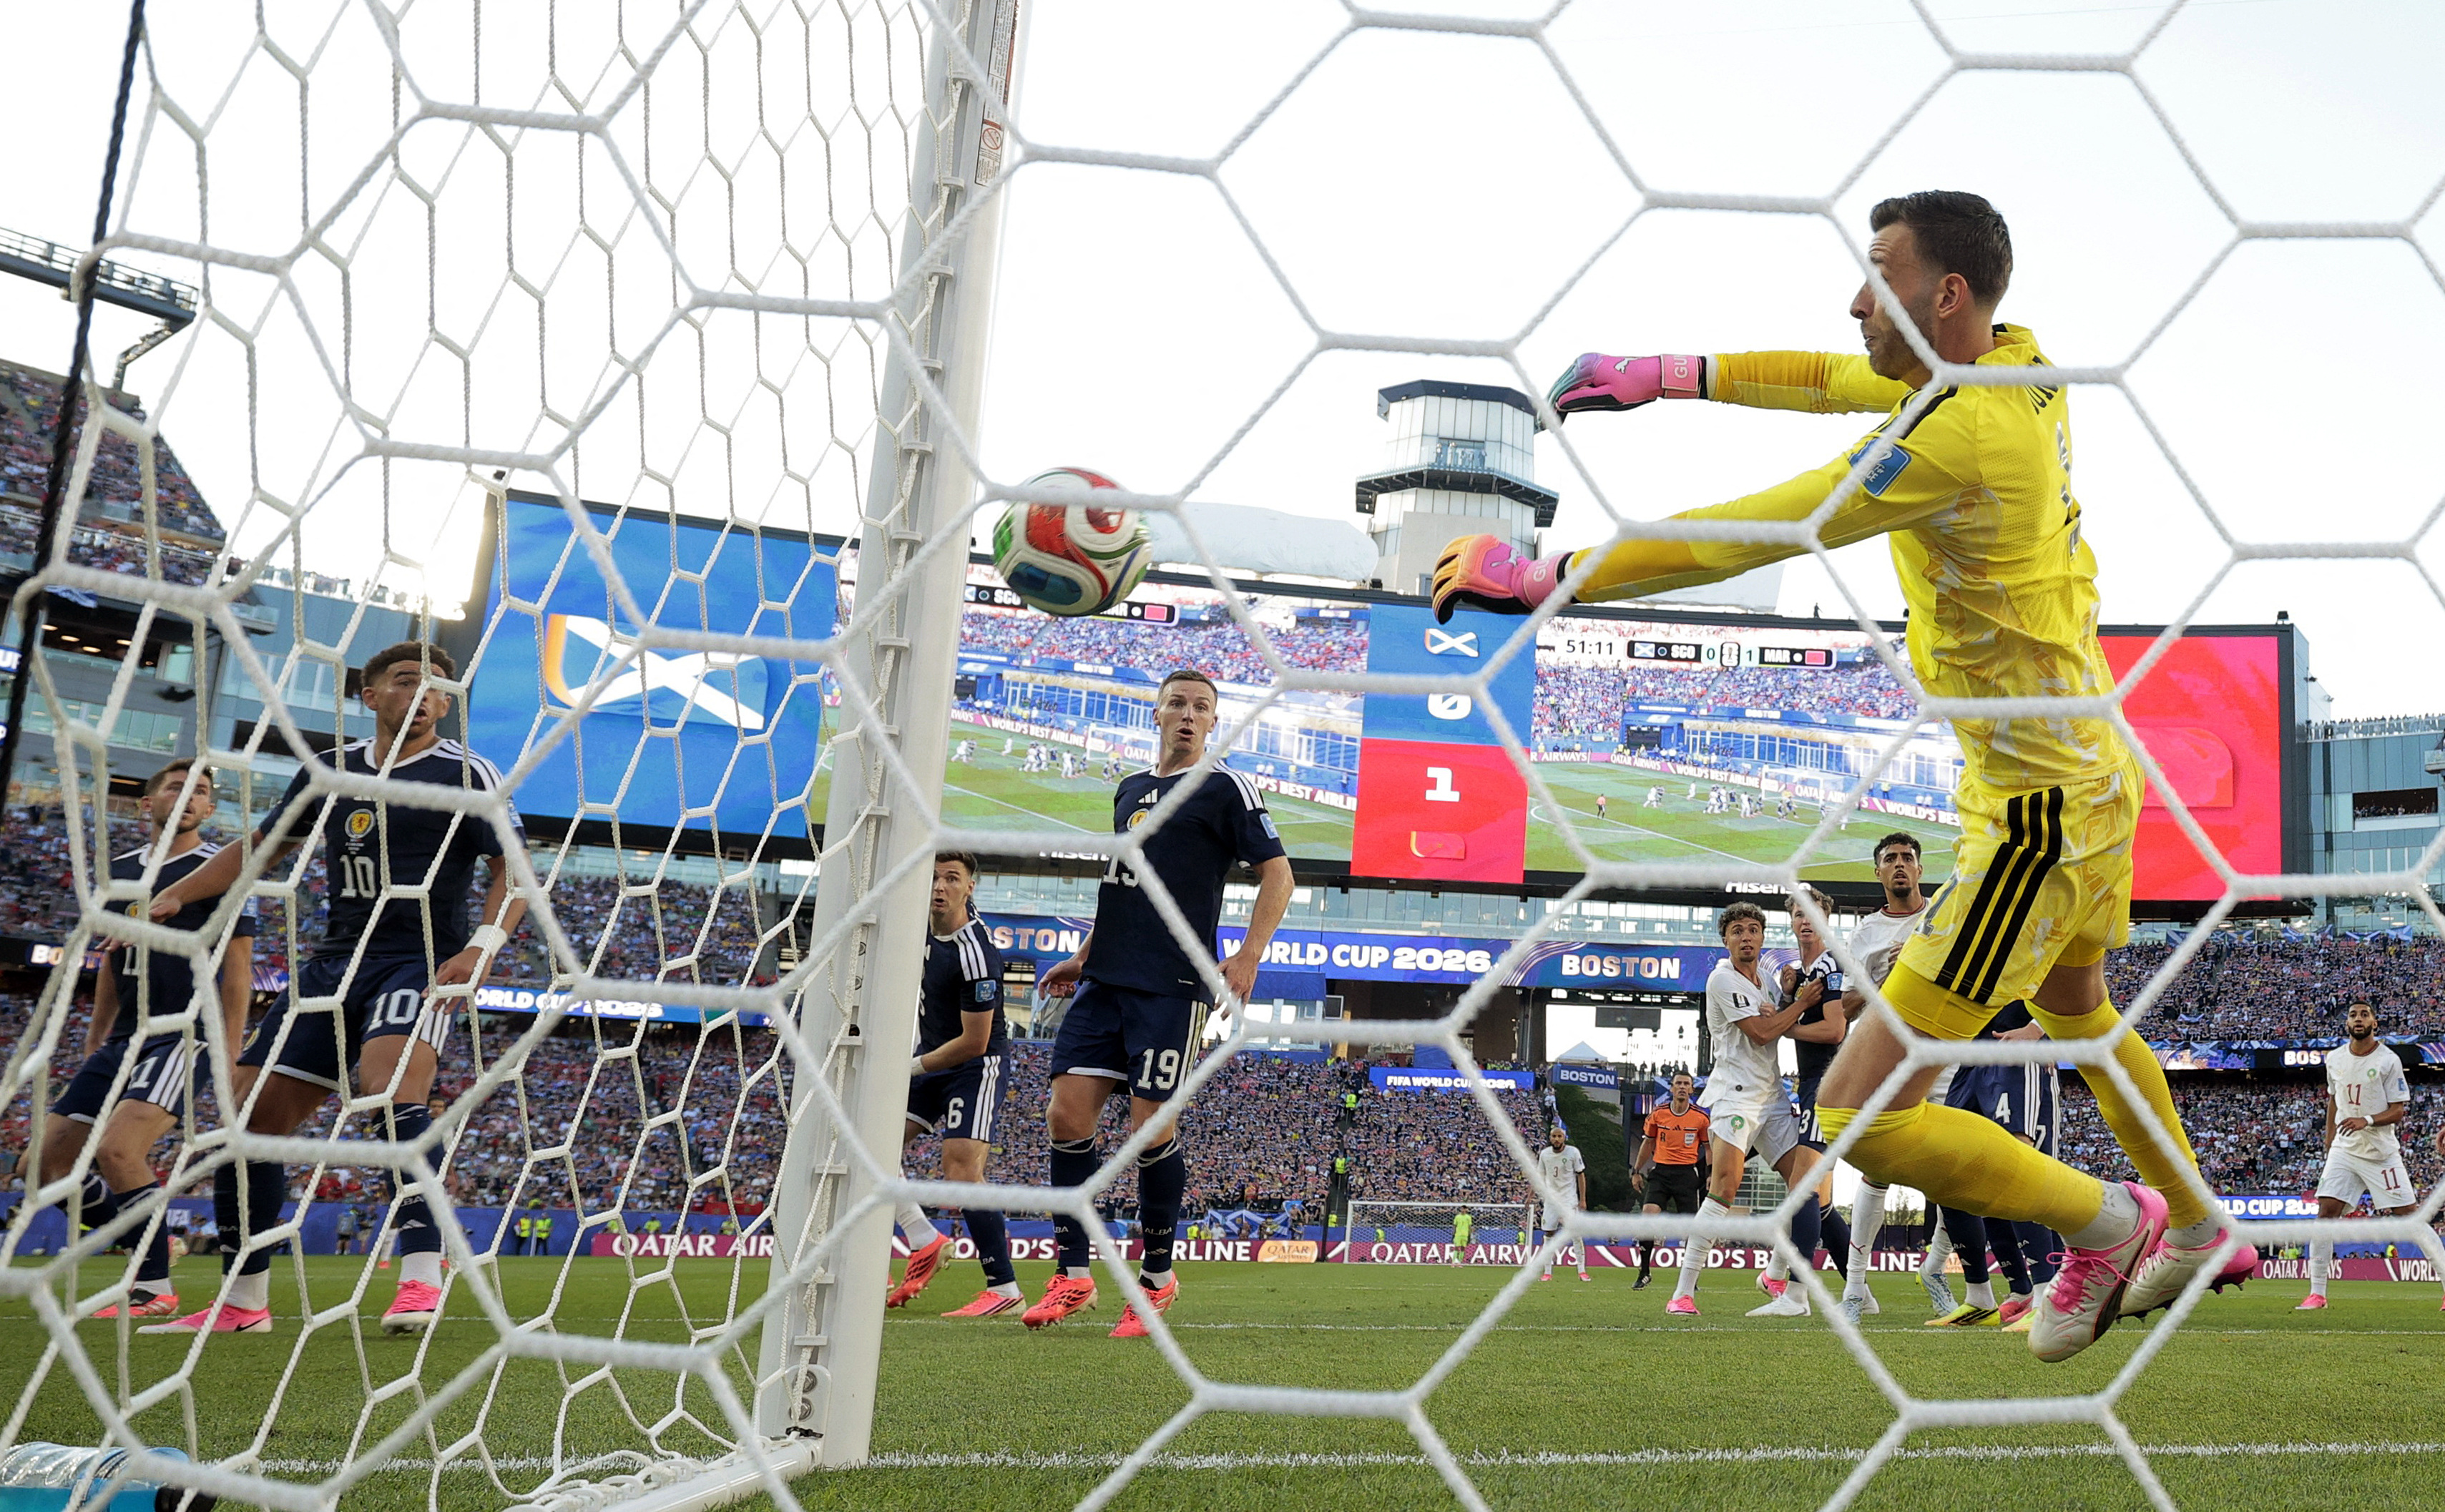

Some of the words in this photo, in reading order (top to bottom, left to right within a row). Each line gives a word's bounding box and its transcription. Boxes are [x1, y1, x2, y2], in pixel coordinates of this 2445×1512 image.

[1566, 639, 1613, 655] 51:11
[1670, 644, 1695, 659] SCO
[1706, 647, 1715, 660] 0
[1745, 649, 1753, 662] 1
[1763, 649, 1790, 663] MAR
[991, 716, 1028, 734] WORLD'S
[1029, 723, 1050, 740] BEST
[1050, 729, 1084, 748] AIRLINE
[1542, 751, 1587, 762] AIRWAYS
[1611, 755, 1632, 767] QATAR
[1632, 759, 1661, 771] AIRWAYS
[1425, 767, 1460, 802] 1
[1675, 765, 1710, 780] WORLD'S
[1710, 771, 1728, 783] BEST
[1729, 776, 1760, 789] AIRLINE
[1279, 780, 1313, 800] BEST
[1885, 801, 1937, 823] WORLD'S
[340, 855, 376, 899] 10
[1331, 943, 1389, 969] CUP
[1392, 947, 1491, 973] 2026
[1561, 953, 1680, 979] BOSTON
[474, 988, 535, 1009] ORLD
[366, 988, 421, 1034] 10
[1136, 1048, 1180, 1091] 19
[1560, 1069, 1615, 1086] BOSTON
[1386, 1076, 1411, 1086] FIFA
[1412, 1076, 1453, 1088] WORLD
[2346, 1083, 2361, 1106] 11
[947, 1097, 965, 1129] 6
[1994, 1092, 2012, 1124] 4
[1552, 1166, 1559, 1178] 3
[2381, 1167, 2401, 1191] 11
[2248, 1199, 2284, 1215] CUP
[1145, 1227, 1172, 1236] ALBA
[612, 1233, 717, 1257] QATAR
[1267, 1245, 1310, 1255] QATAR
[1371, 1242, 1456, 1264] QATAR
[2263, 1260, 2298, 1280] QATAR
